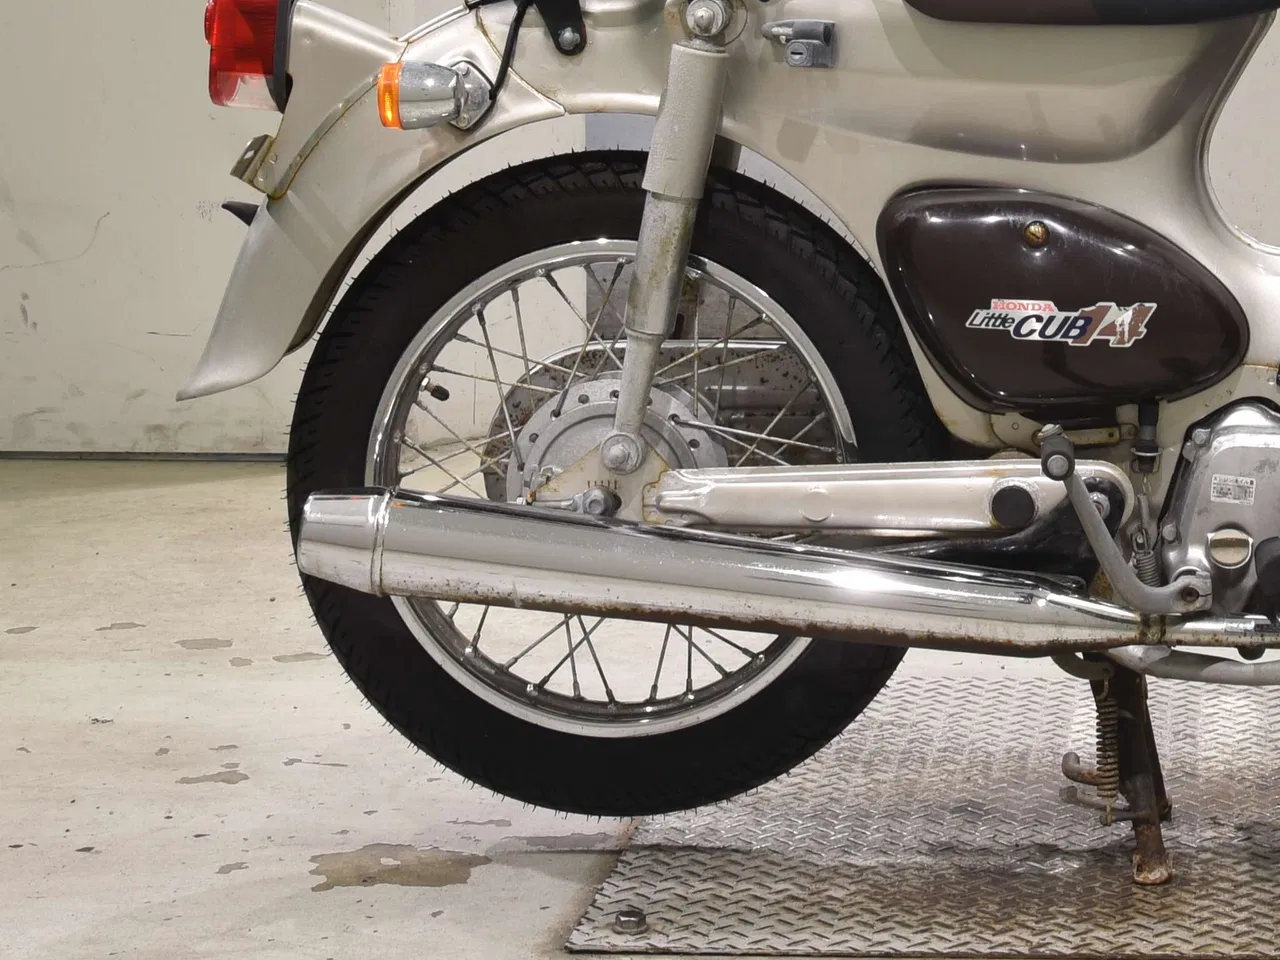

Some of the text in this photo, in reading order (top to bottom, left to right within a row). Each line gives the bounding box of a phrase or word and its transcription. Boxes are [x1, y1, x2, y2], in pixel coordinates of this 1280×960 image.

[992, 301, 1055, 313] HONDA
[968, 312, 1015, 329] Little
[1012, 314, 1093, 340] CUB
